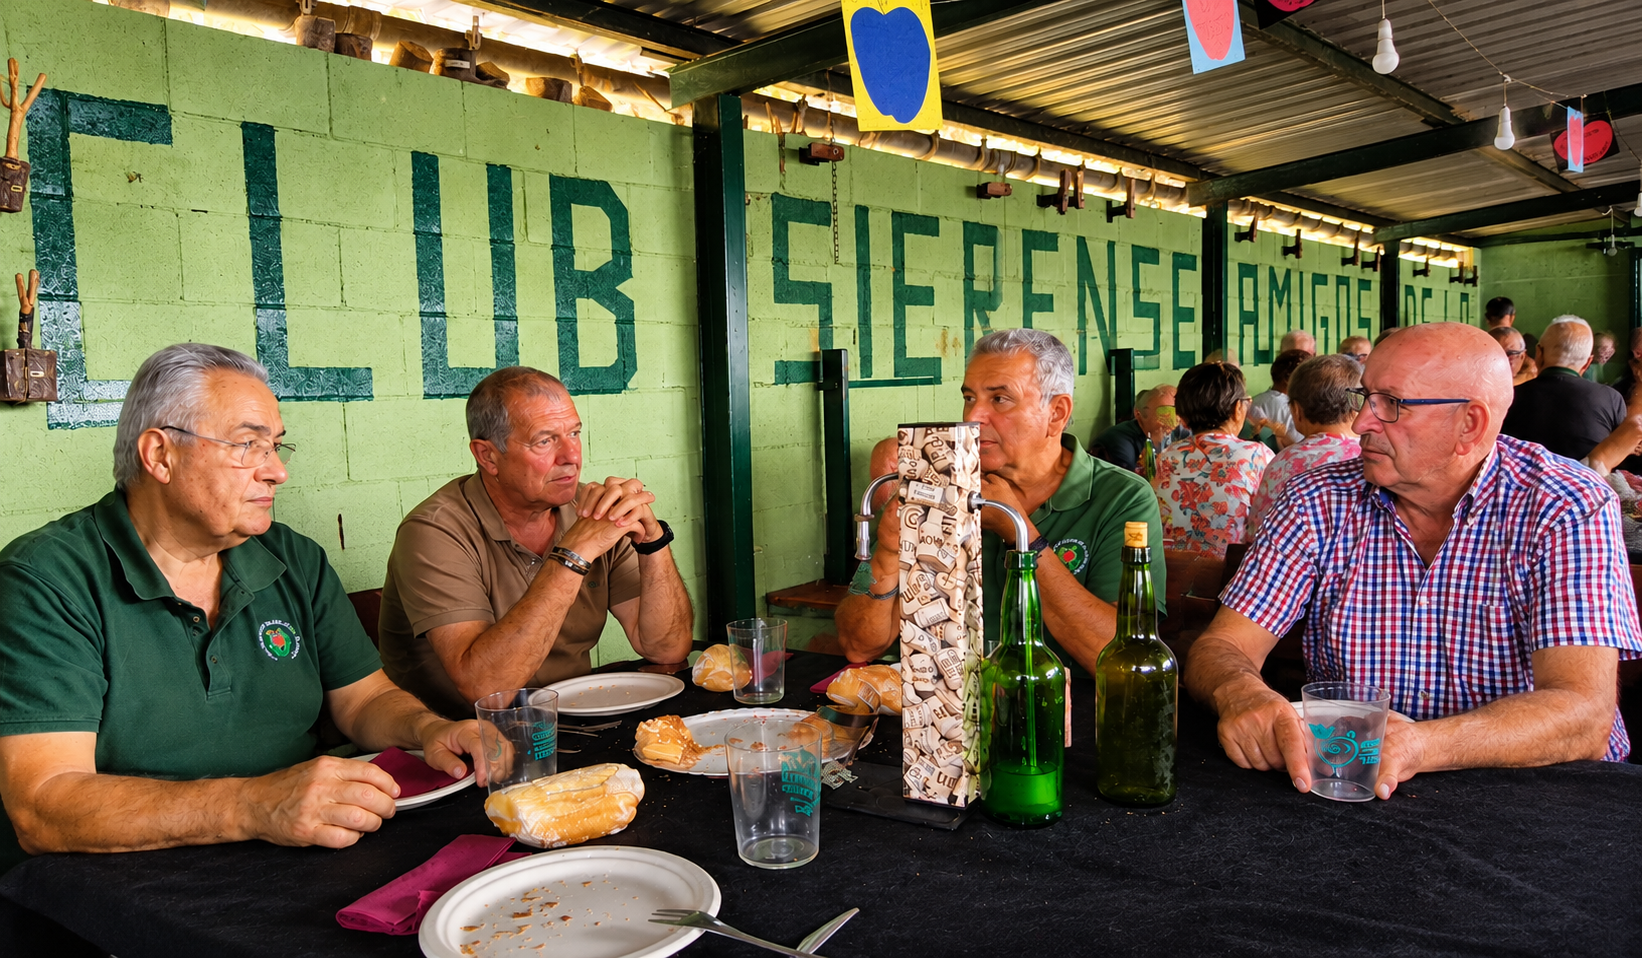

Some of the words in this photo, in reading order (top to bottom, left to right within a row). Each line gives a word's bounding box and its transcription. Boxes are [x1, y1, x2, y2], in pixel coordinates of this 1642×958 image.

[27, 85, 638, 430] CLUB
[771, 192, 1197, 386] SIERENSE
[1238, 262, 1372, 367] AMIGOS
